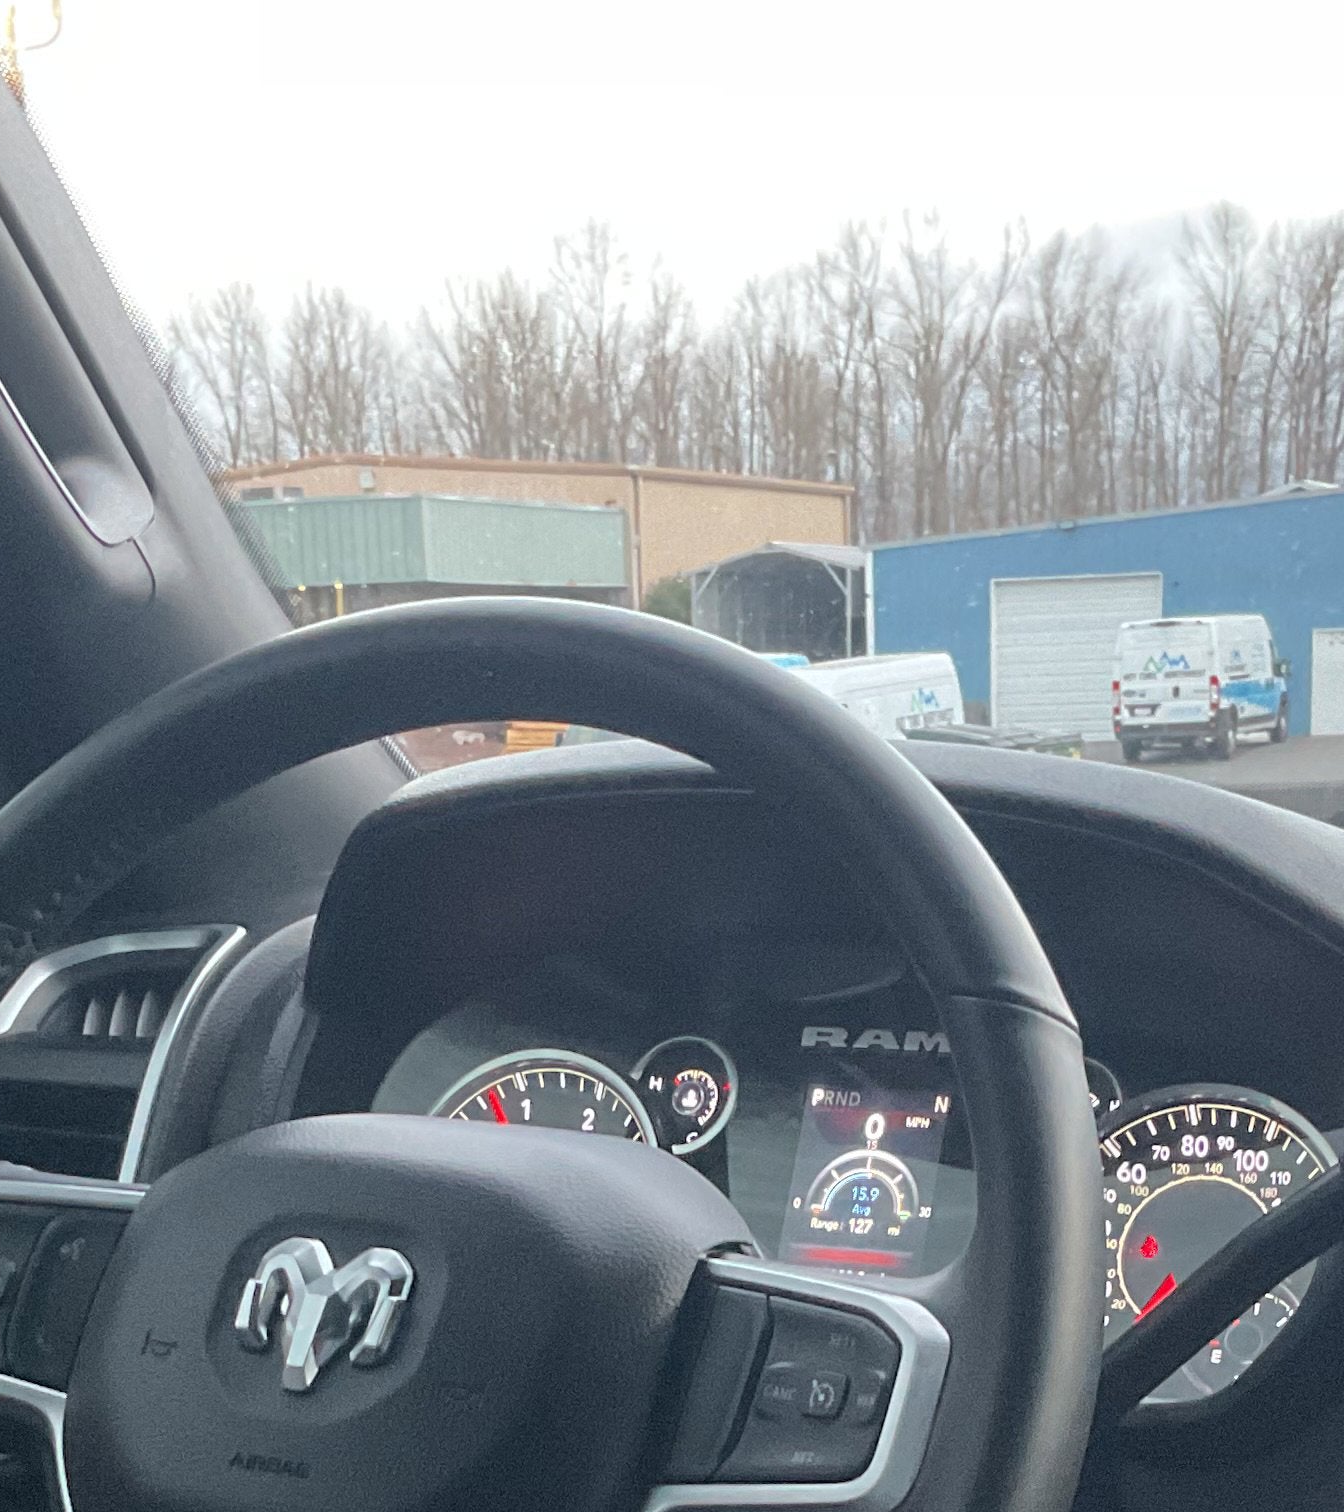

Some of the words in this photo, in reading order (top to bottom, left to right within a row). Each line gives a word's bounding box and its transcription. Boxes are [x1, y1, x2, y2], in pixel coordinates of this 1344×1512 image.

[801, 1026, 951, 1053] RAM
[520, 1098, 532, 1122] 1
[933, 1095, 950, 1114] N
[581, 1107, 596, 1131] 2
[864, 1112, 886, 1141] 0
[905, 1115, 932, 1129] MPH
[1180, 1134, 1209, 1158] 80
[1216, 1136, 1235, 1151] 90
[1151, 1145, 1171, 1161] 70
[1232, 1149, 1269, 1172] 100
[1116, 1160, 1147, 1184] 60
[1171, 1162, 1191, 1176] 120
[1204, 1162, 1224, 1175] 140
[1239, 1172, 1258, 1185] 160
[1269, 1170, 1292, 1186] 110
[851, 1185, 881, 1202] 15.9
[1129, 1184, 1150, 1198] 100
[1259, 1186, 1278, 1199] 180
[1117, 1202, 1132, 1216] 80
[848, 1217, 874, 1235] 127
[1111, 1298, 1127, 1311] 20
[1210, 1347, 1223, 1364] E
